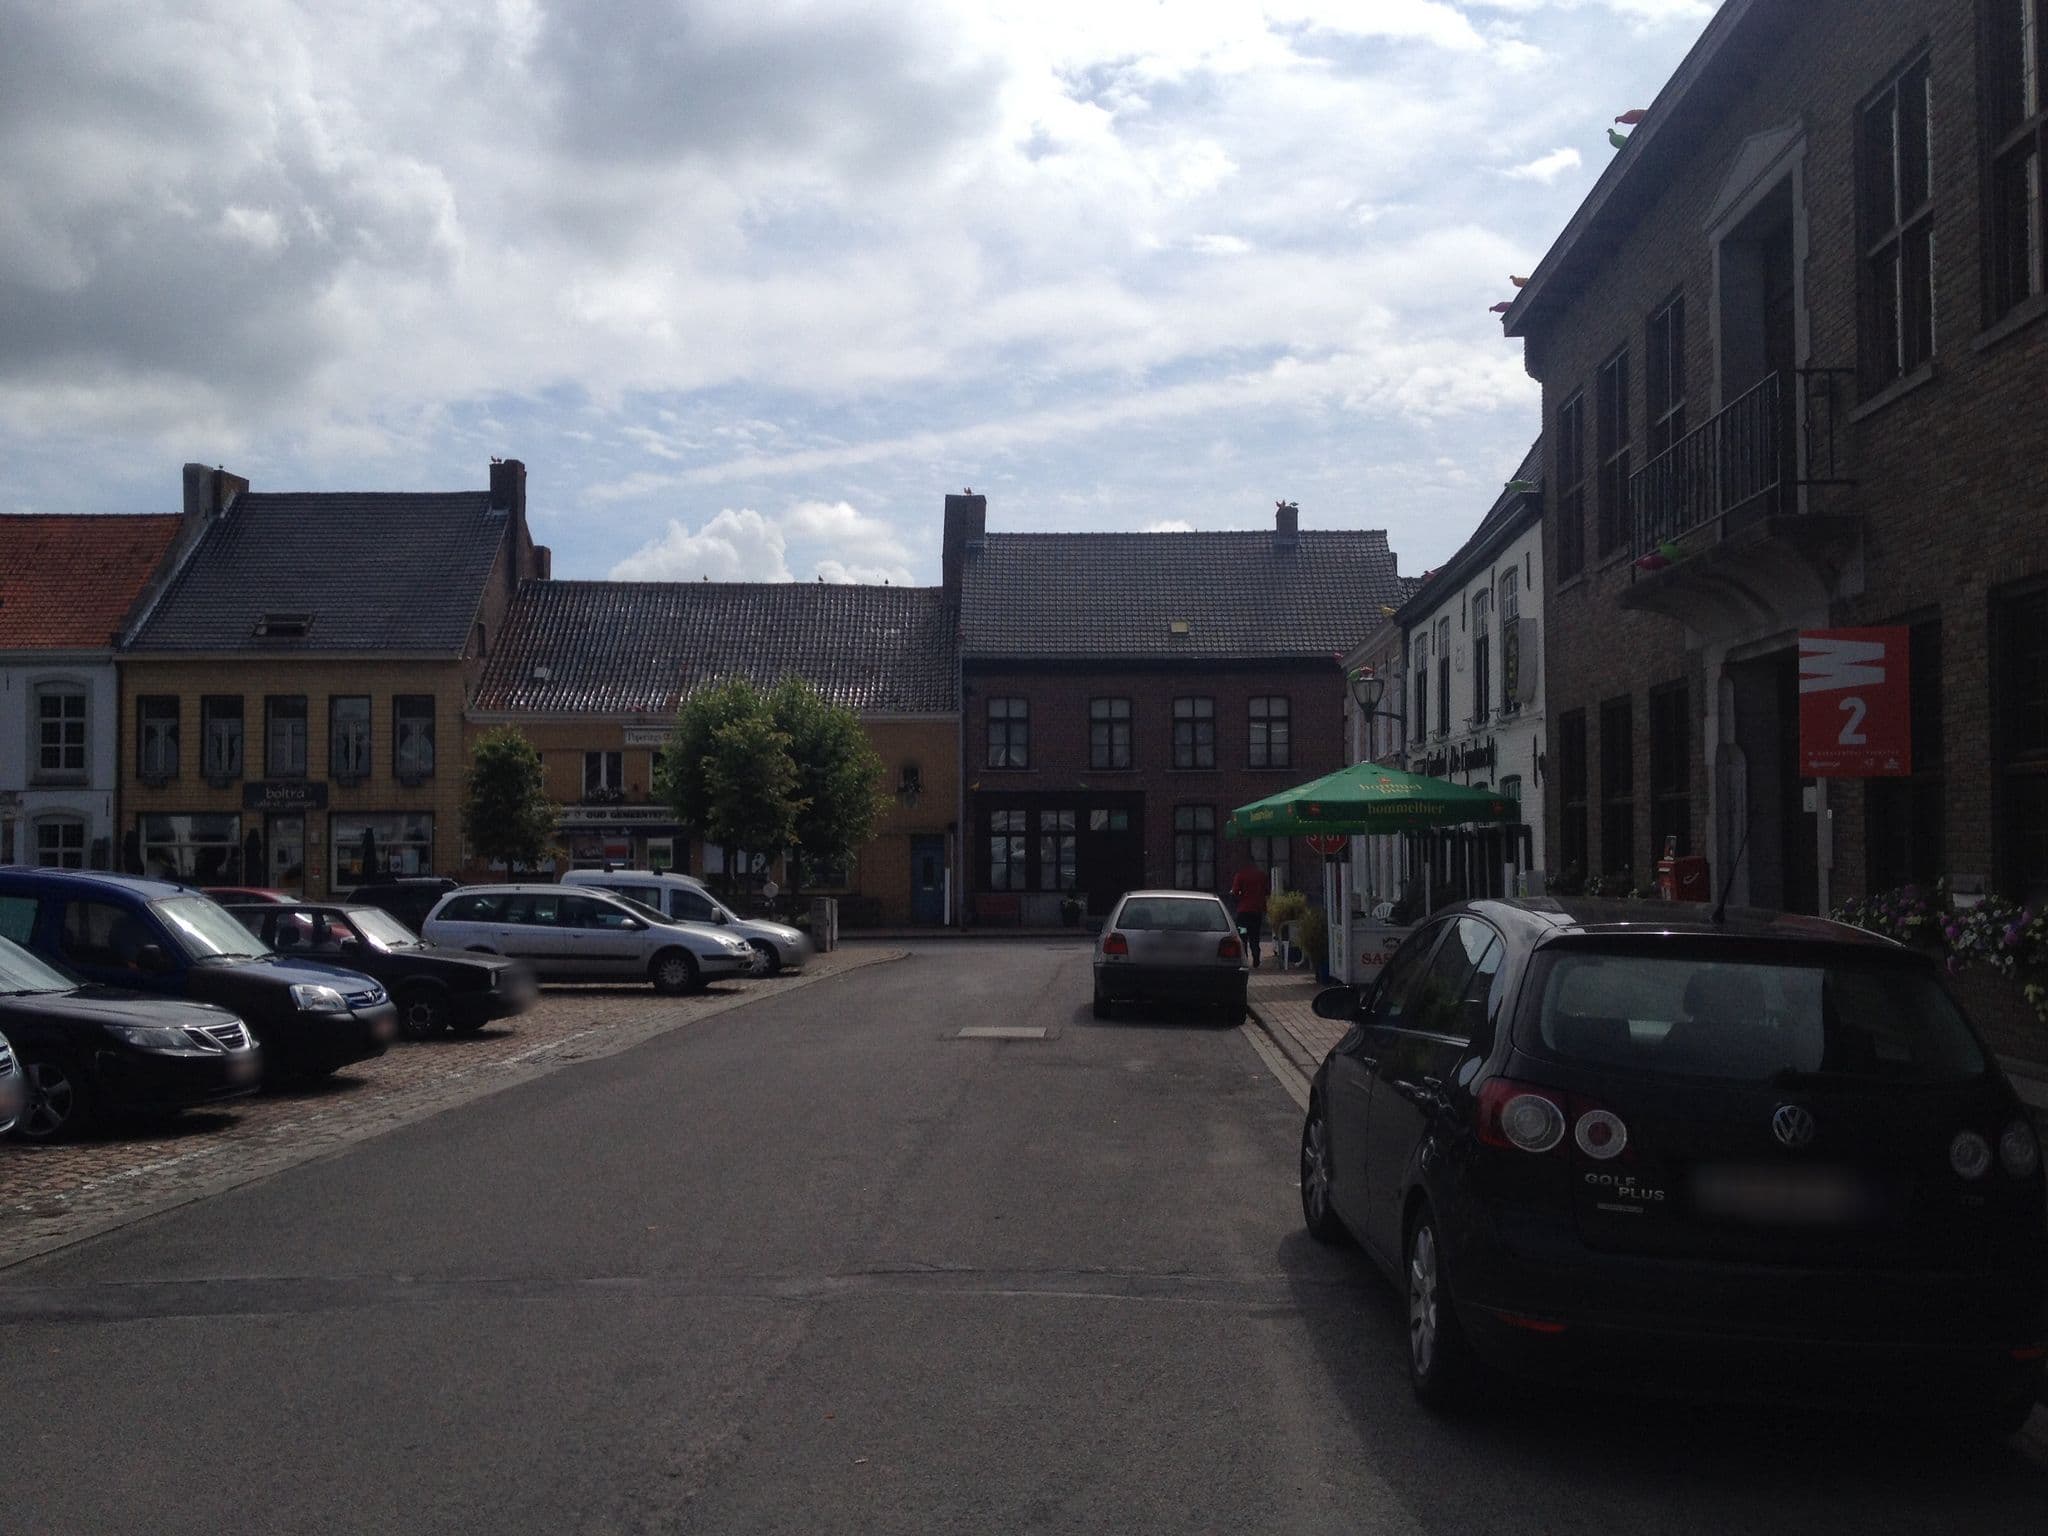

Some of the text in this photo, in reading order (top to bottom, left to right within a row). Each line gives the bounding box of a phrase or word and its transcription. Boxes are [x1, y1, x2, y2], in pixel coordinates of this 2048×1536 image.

[1838, 696, 1867, 745] 2
[1367, 801, 1445, 816] hommelbier
[1584, 1173, 1636, 1187] GOLF
[1618, 1186, 1665, 1201] PLUS
